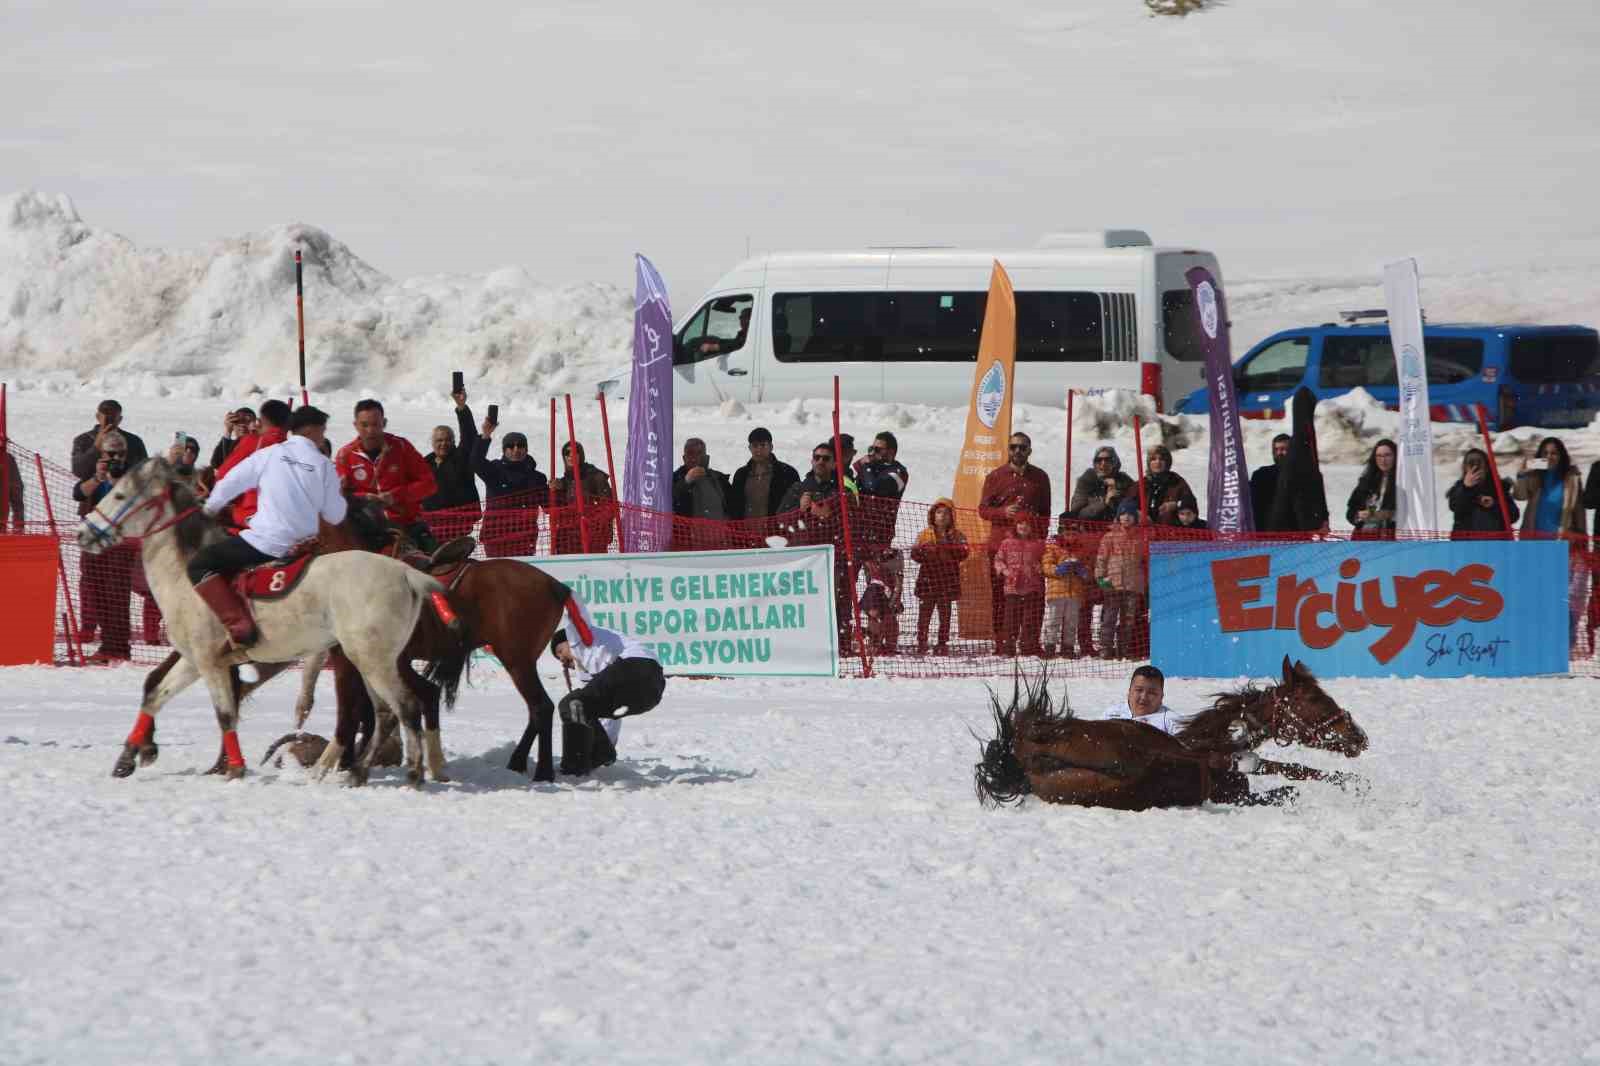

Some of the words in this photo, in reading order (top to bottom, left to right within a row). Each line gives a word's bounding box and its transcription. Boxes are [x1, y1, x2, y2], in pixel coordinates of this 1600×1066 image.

[269, 571, 286, 592] 8
[671, 569, 818, 600] GELENEKSEL
[635, 607, 697, 635] SPOR
[704, 603, 806, 632] DALLARI
[1210, 553, 1505, 665] Erciyes
[643, 638, 771, 666] RASYONU
[1455, 632, 1511, 668] Resort
